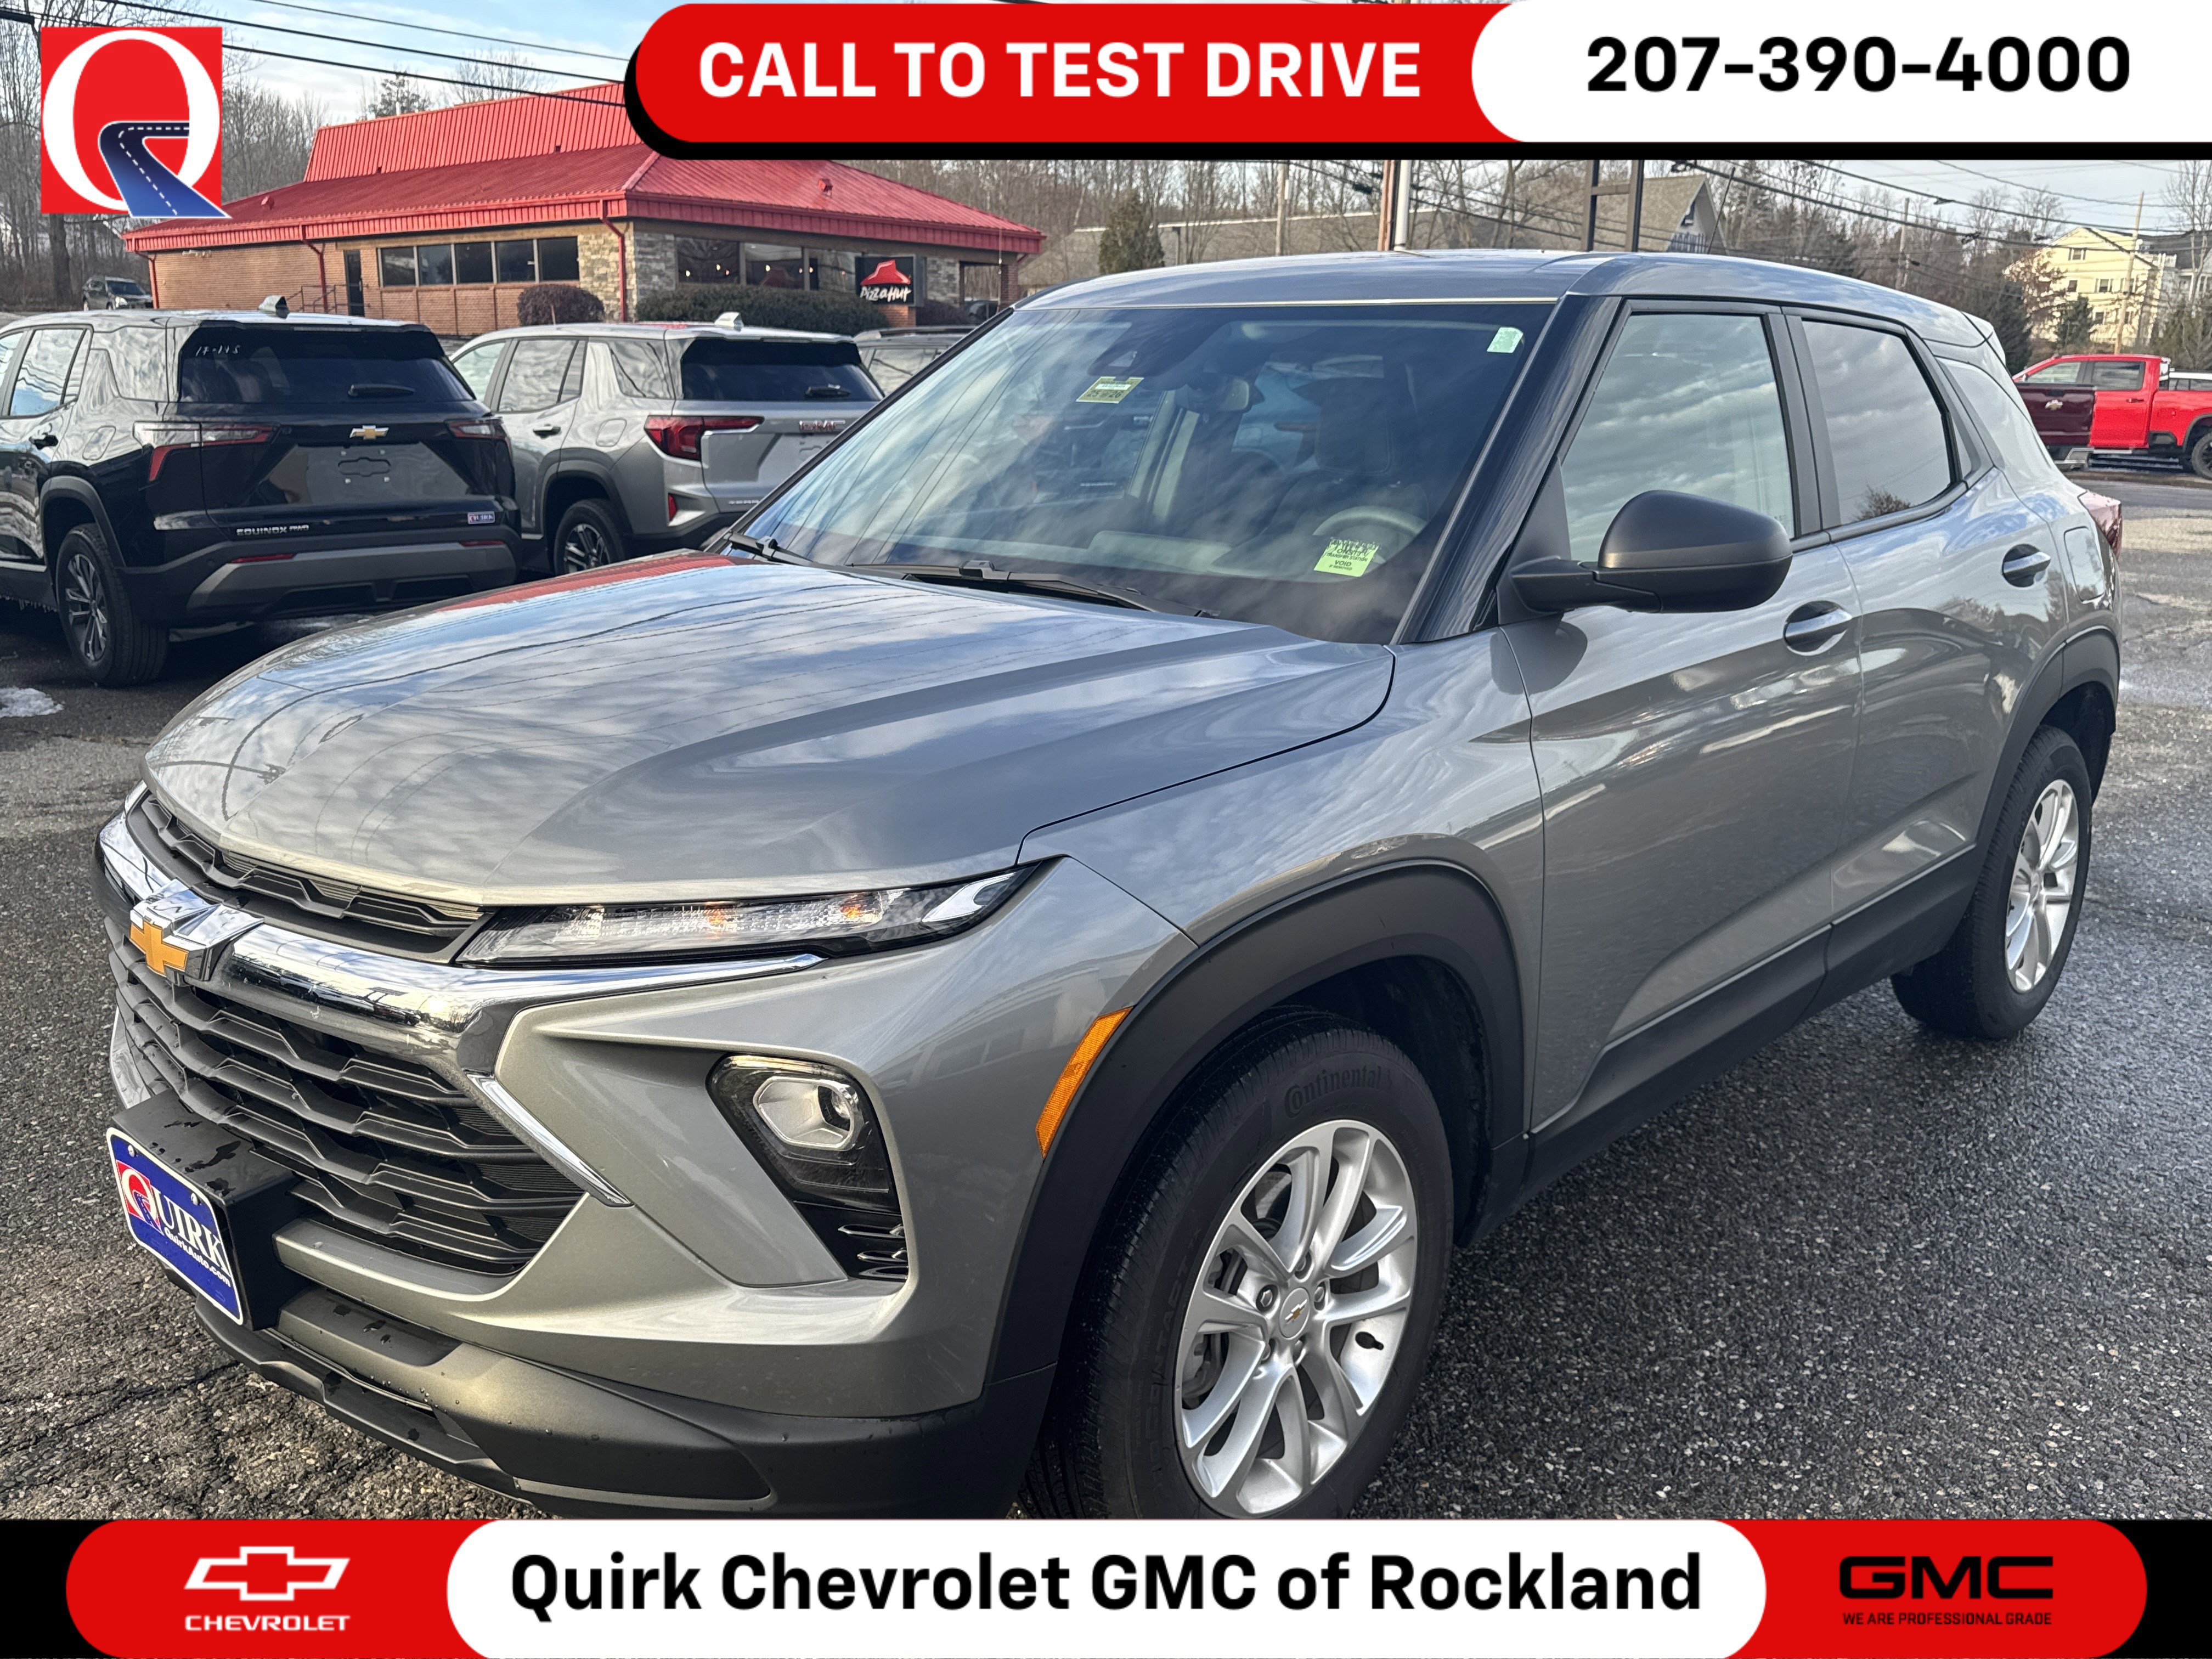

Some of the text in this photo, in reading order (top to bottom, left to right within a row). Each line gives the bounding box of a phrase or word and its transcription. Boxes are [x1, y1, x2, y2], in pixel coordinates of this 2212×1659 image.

[799, 420, 845, 432] GMC
[236, 527, 287, 535] EQUINOX
[1284, 1065, 1381, 1118] Continental
[121, 1169, 232, 1278] QUIRK
[164, 1226, 231, 1288] QuirkAuto.com
